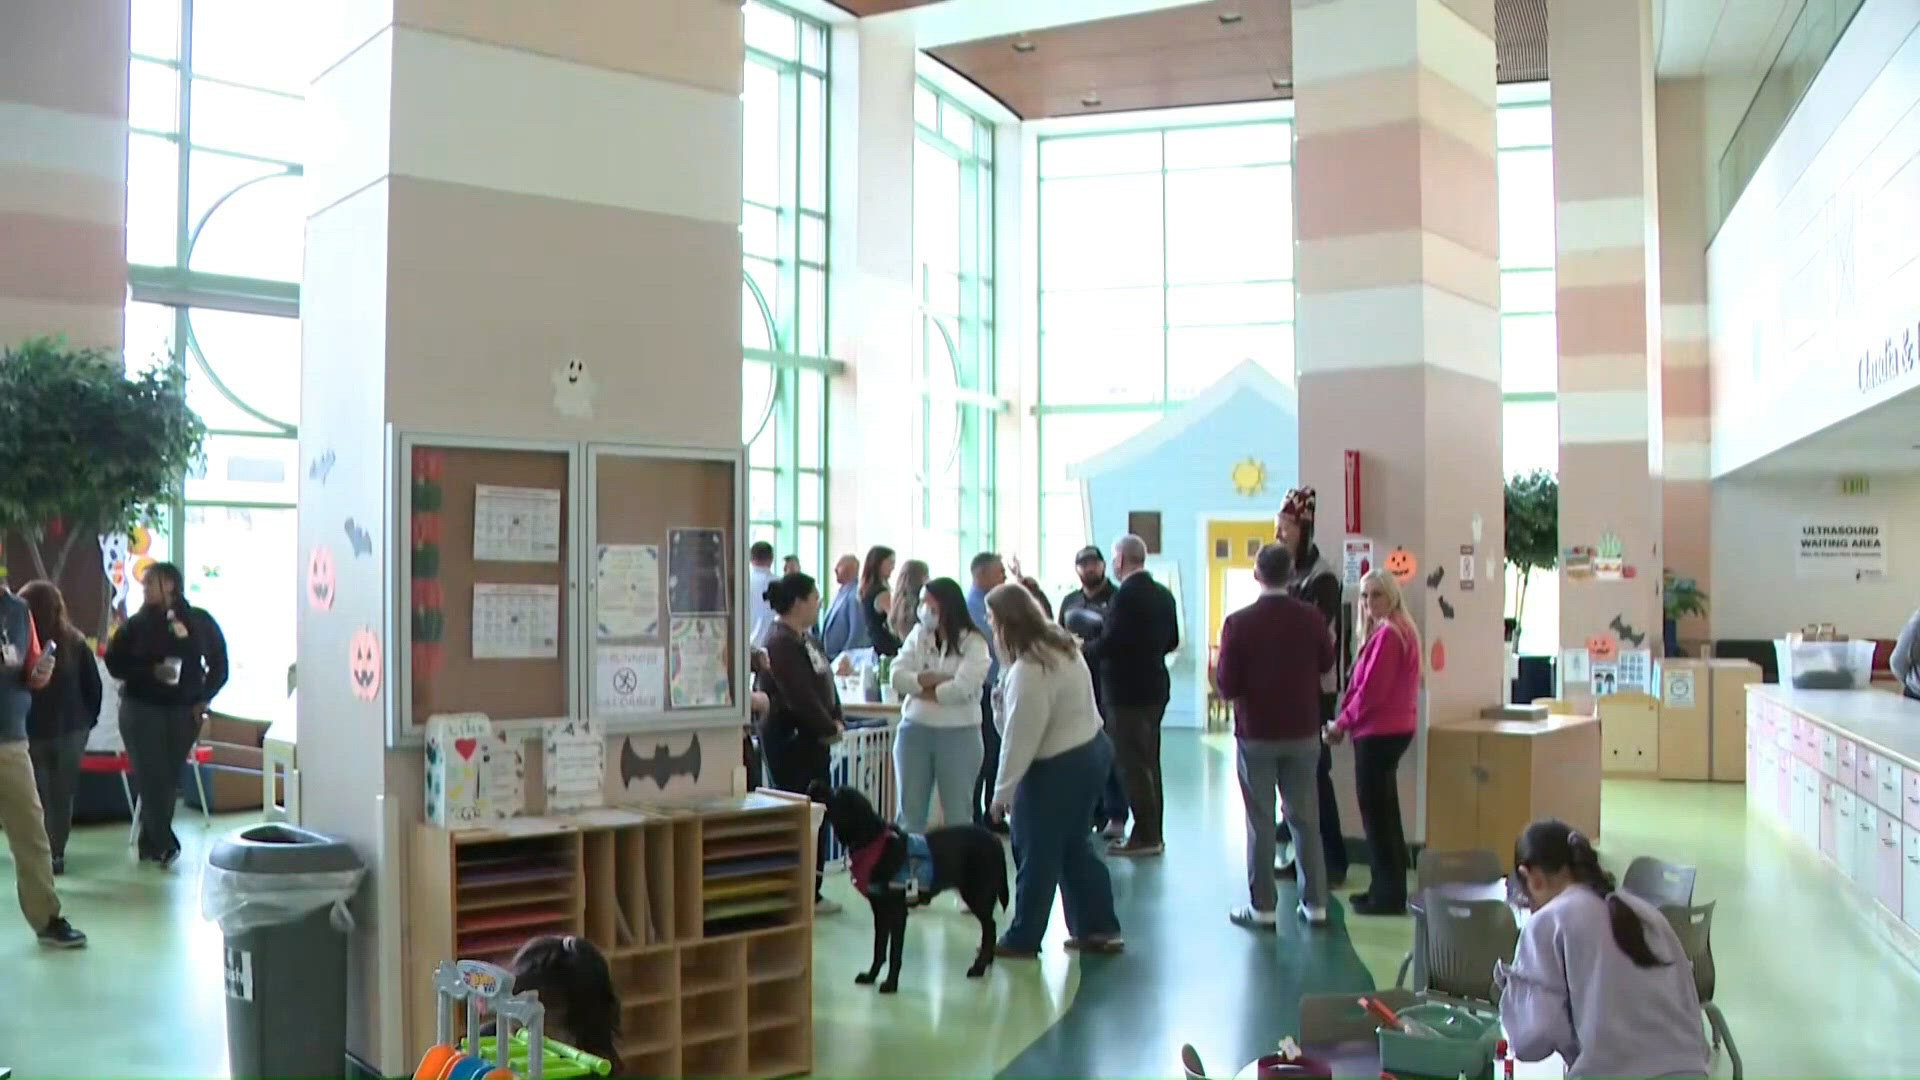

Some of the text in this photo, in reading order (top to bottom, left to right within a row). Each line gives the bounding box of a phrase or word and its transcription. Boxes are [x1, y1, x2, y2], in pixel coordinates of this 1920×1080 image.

[1802, 526, 1879, 535] ULTRASOUND
[1801, 539, 1881, 548] WAITING AREA
